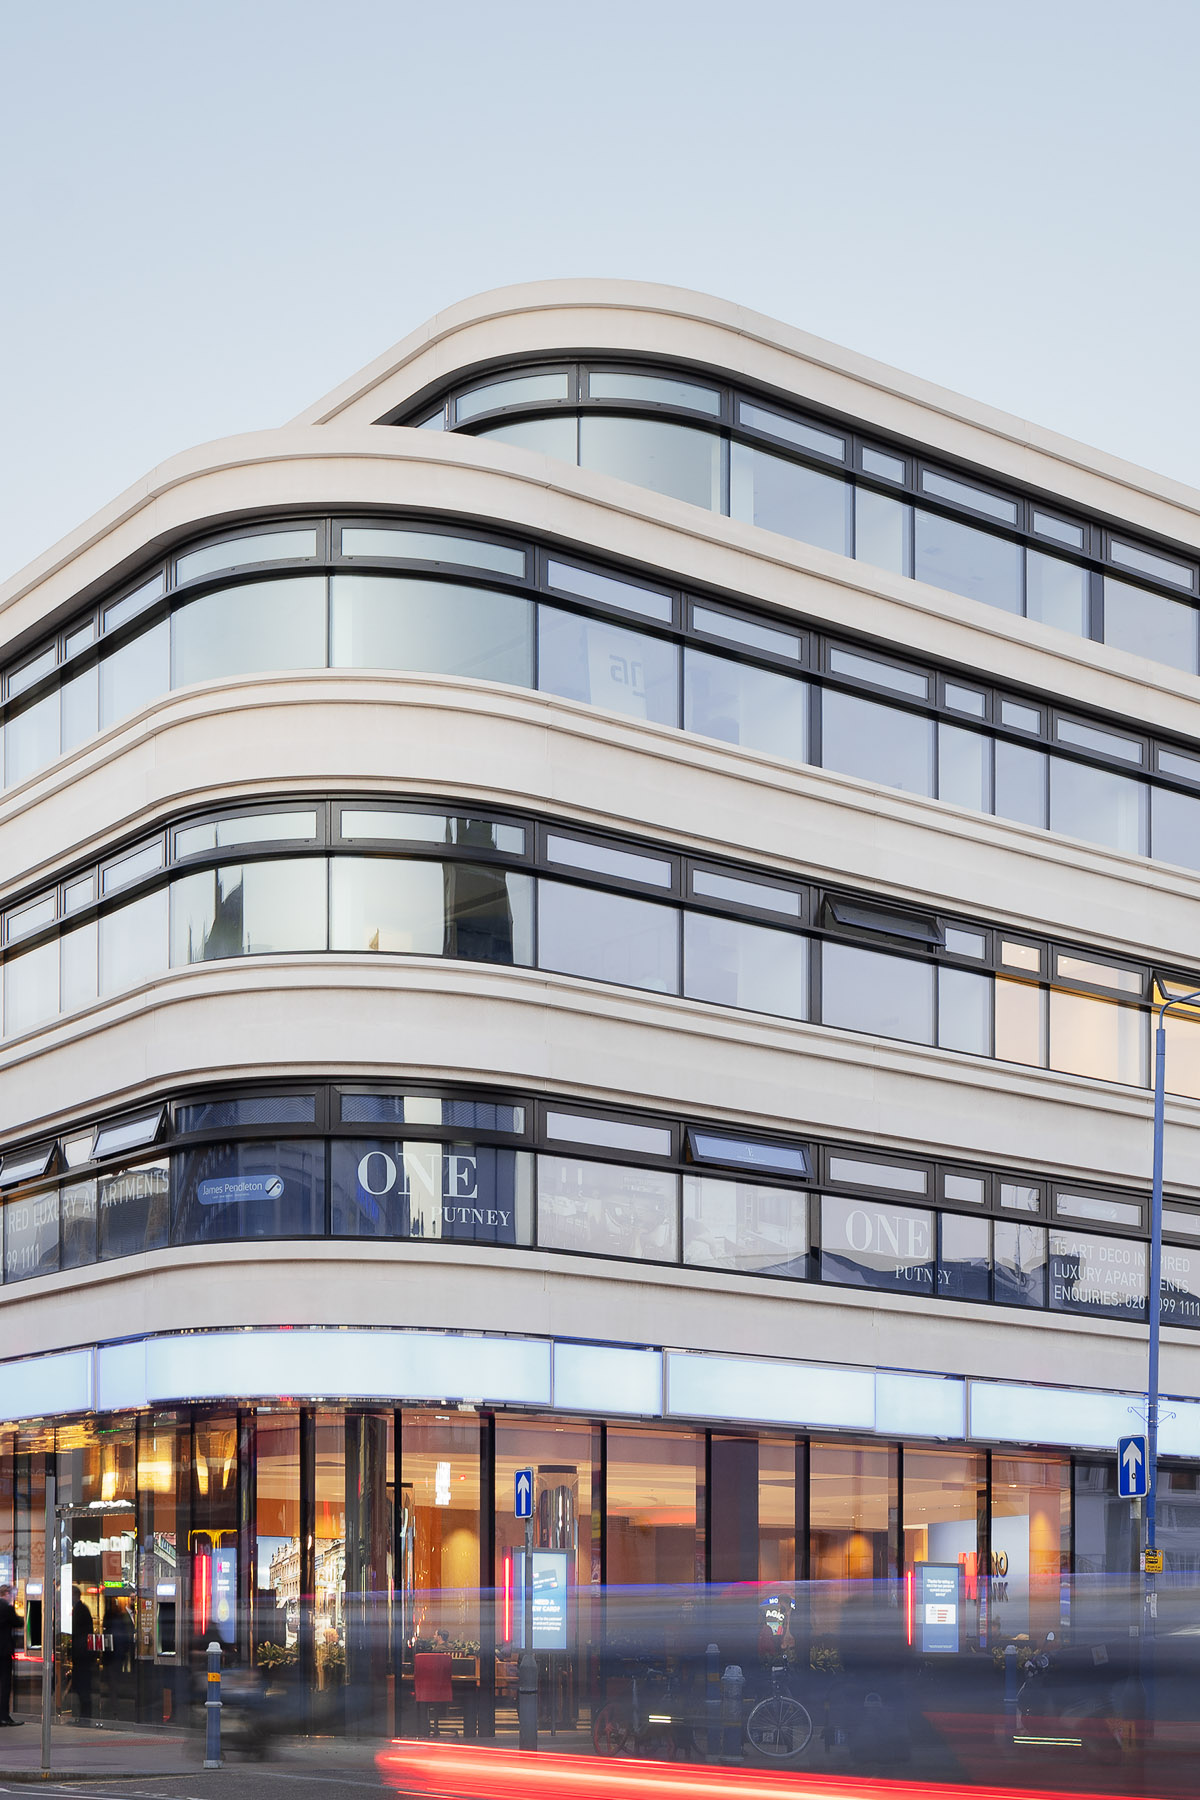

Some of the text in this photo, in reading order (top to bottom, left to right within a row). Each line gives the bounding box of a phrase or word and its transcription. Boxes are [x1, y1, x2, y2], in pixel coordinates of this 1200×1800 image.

[357, 1151, 478, 1199] ONE
[202, 1182, 263, 1196] James Pendleton
[432, 1206, 511, 1227] PUTNEY
[845, 1210, 929, 1259] ONE
[21, 1243, 40, 1269] 1111
[1054, 1241, 1067, 1256] 15
[1070, 1243, 1095, 1259] ART
[1100, 1246, 1131, 1264] DECO
[894, 1264, 952, 1285] PUTNEY
[1054, 1263, 1189, 1294] LUXURY APARTENTS
[1054, 1285, 1122, 1307] ENQUIRIES:
[1125, 1294, 1145, 1310] 020
[1179, 1300, 1200, 1317] 1111
